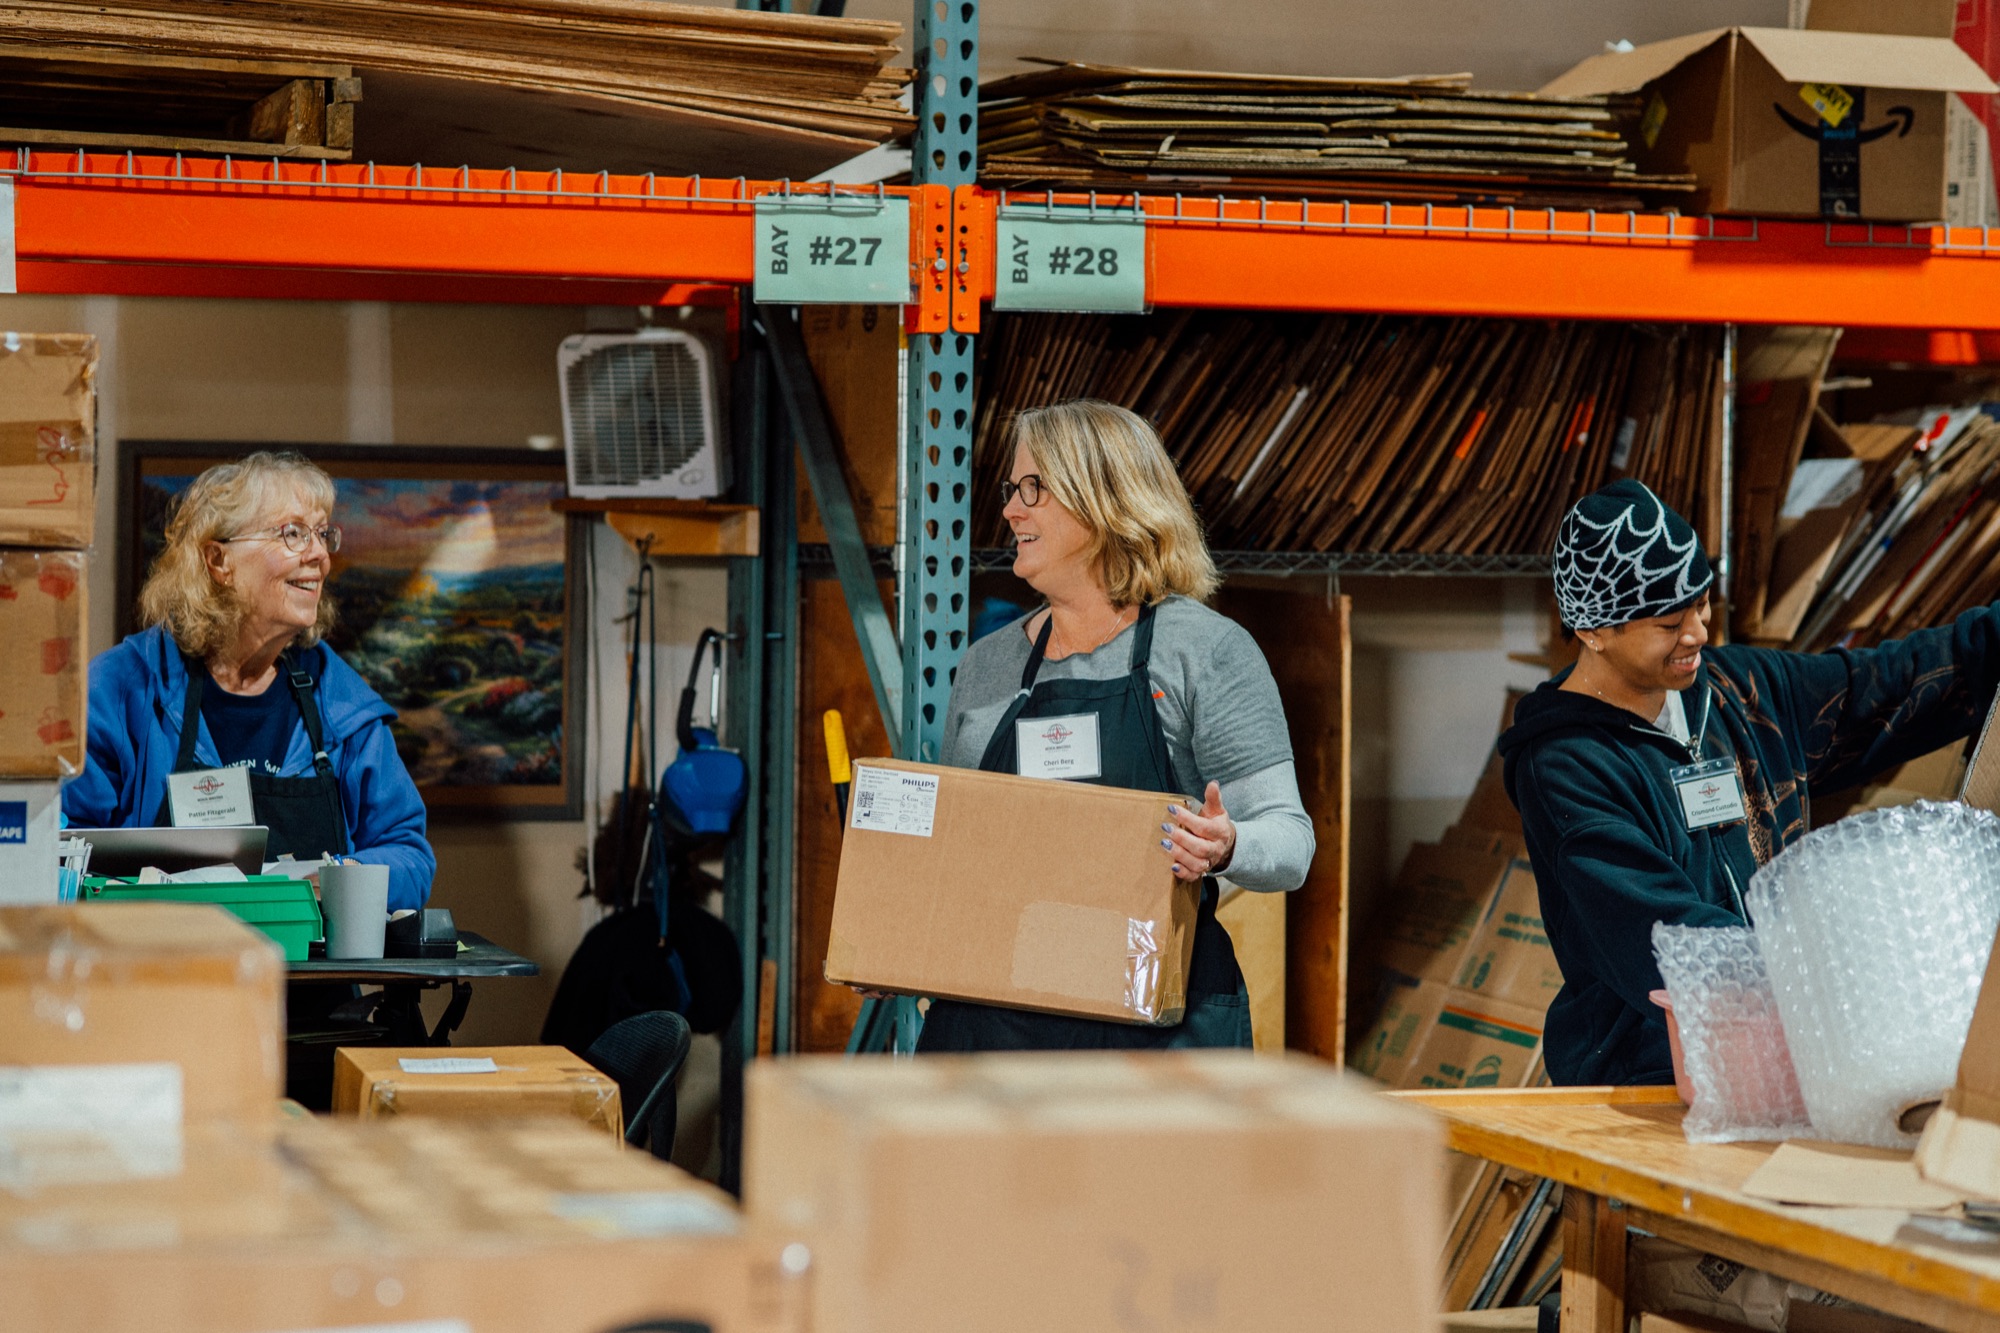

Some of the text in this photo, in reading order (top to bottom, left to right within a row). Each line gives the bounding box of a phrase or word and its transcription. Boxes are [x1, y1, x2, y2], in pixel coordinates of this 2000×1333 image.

[771, 224, 789, 275] BAY
[809, 236, 882, 266] #27
[1012, 234, 1029, 284] BAY
[1049, 246, 1119, 276] #28
[902, 778, 936, 788] PHILIPS
[207, 806, 236, 817] Fitzgerald
[0, 826, 22, 839] APE
